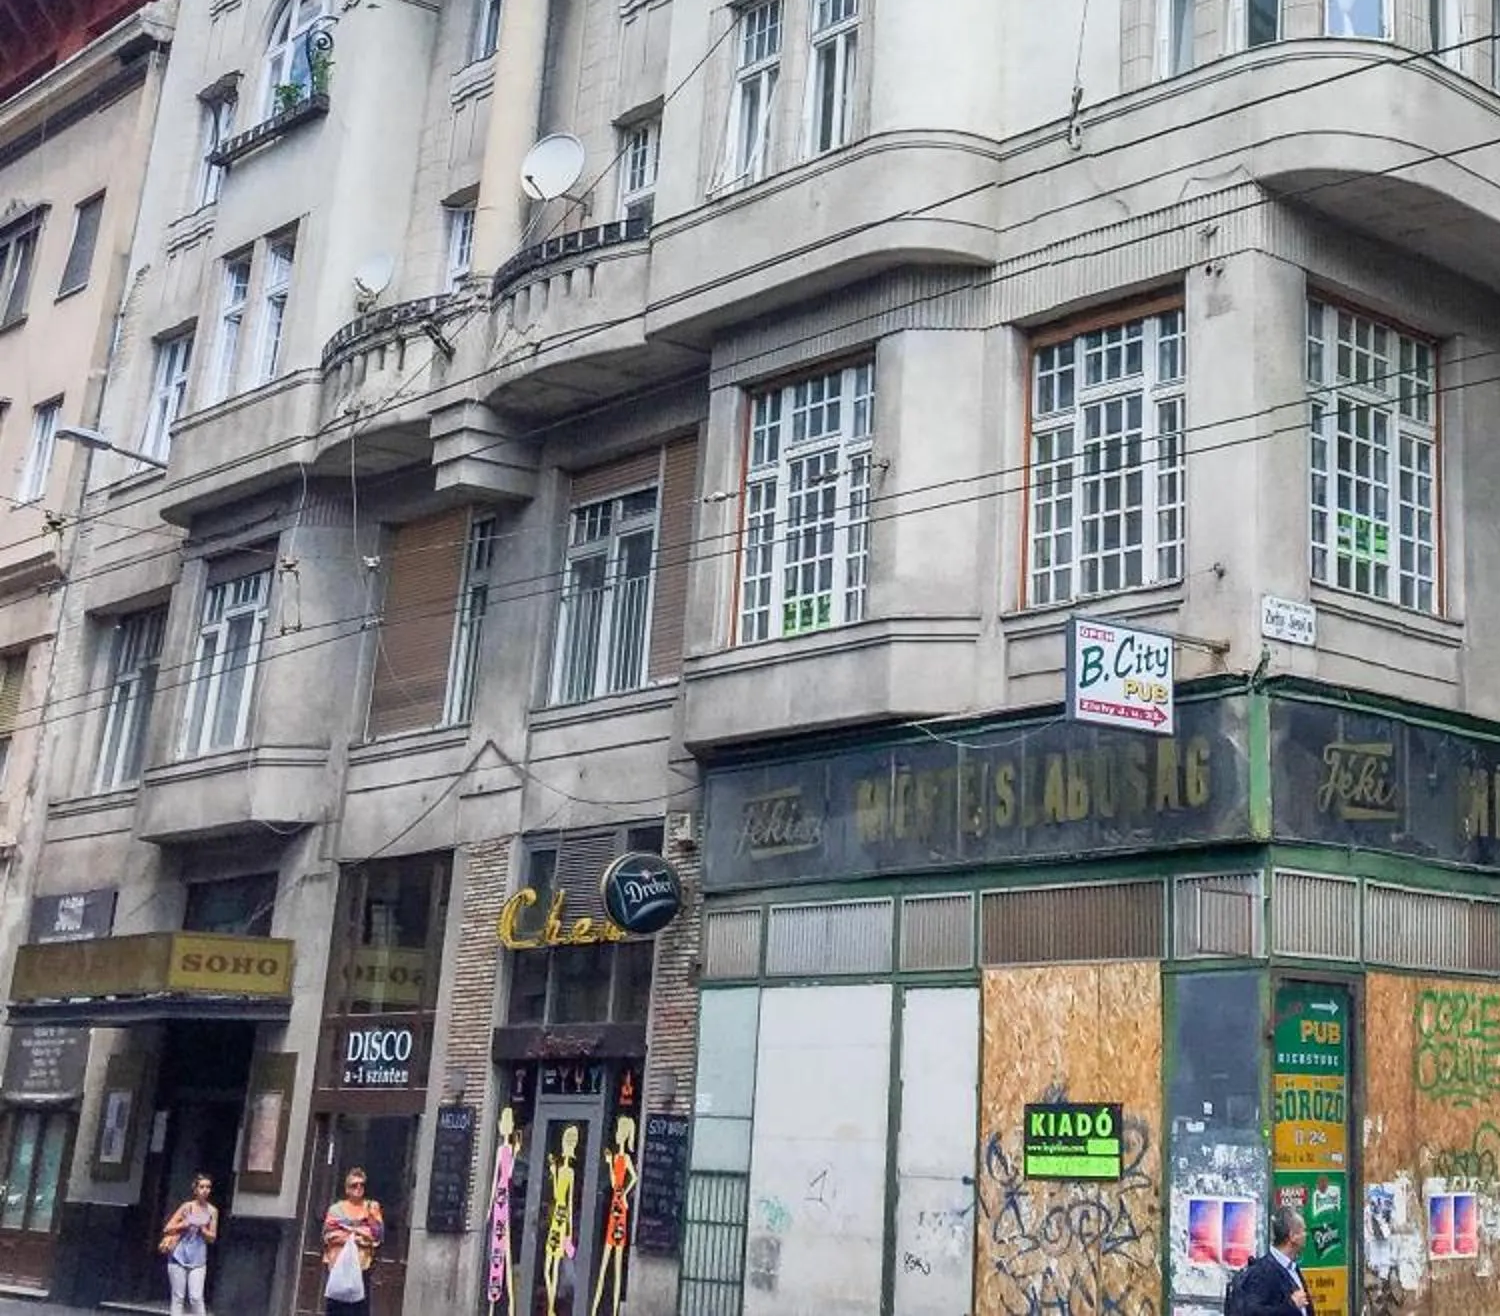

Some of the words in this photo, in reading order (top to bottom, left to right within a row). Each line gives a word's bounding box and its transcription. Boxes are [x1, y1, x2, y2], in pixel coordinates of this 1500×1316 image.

[1081, 627, 1115, 642] OPEN
[1124, 679, 1169, 704] PUB
[181, 952, 279, 976] SOHO
[1301, 1019, 1341, 1045] PUB
[347, 1030, 412, 1062] DISCO
[1031, 1107, 1113, 1137] KIADÓ
